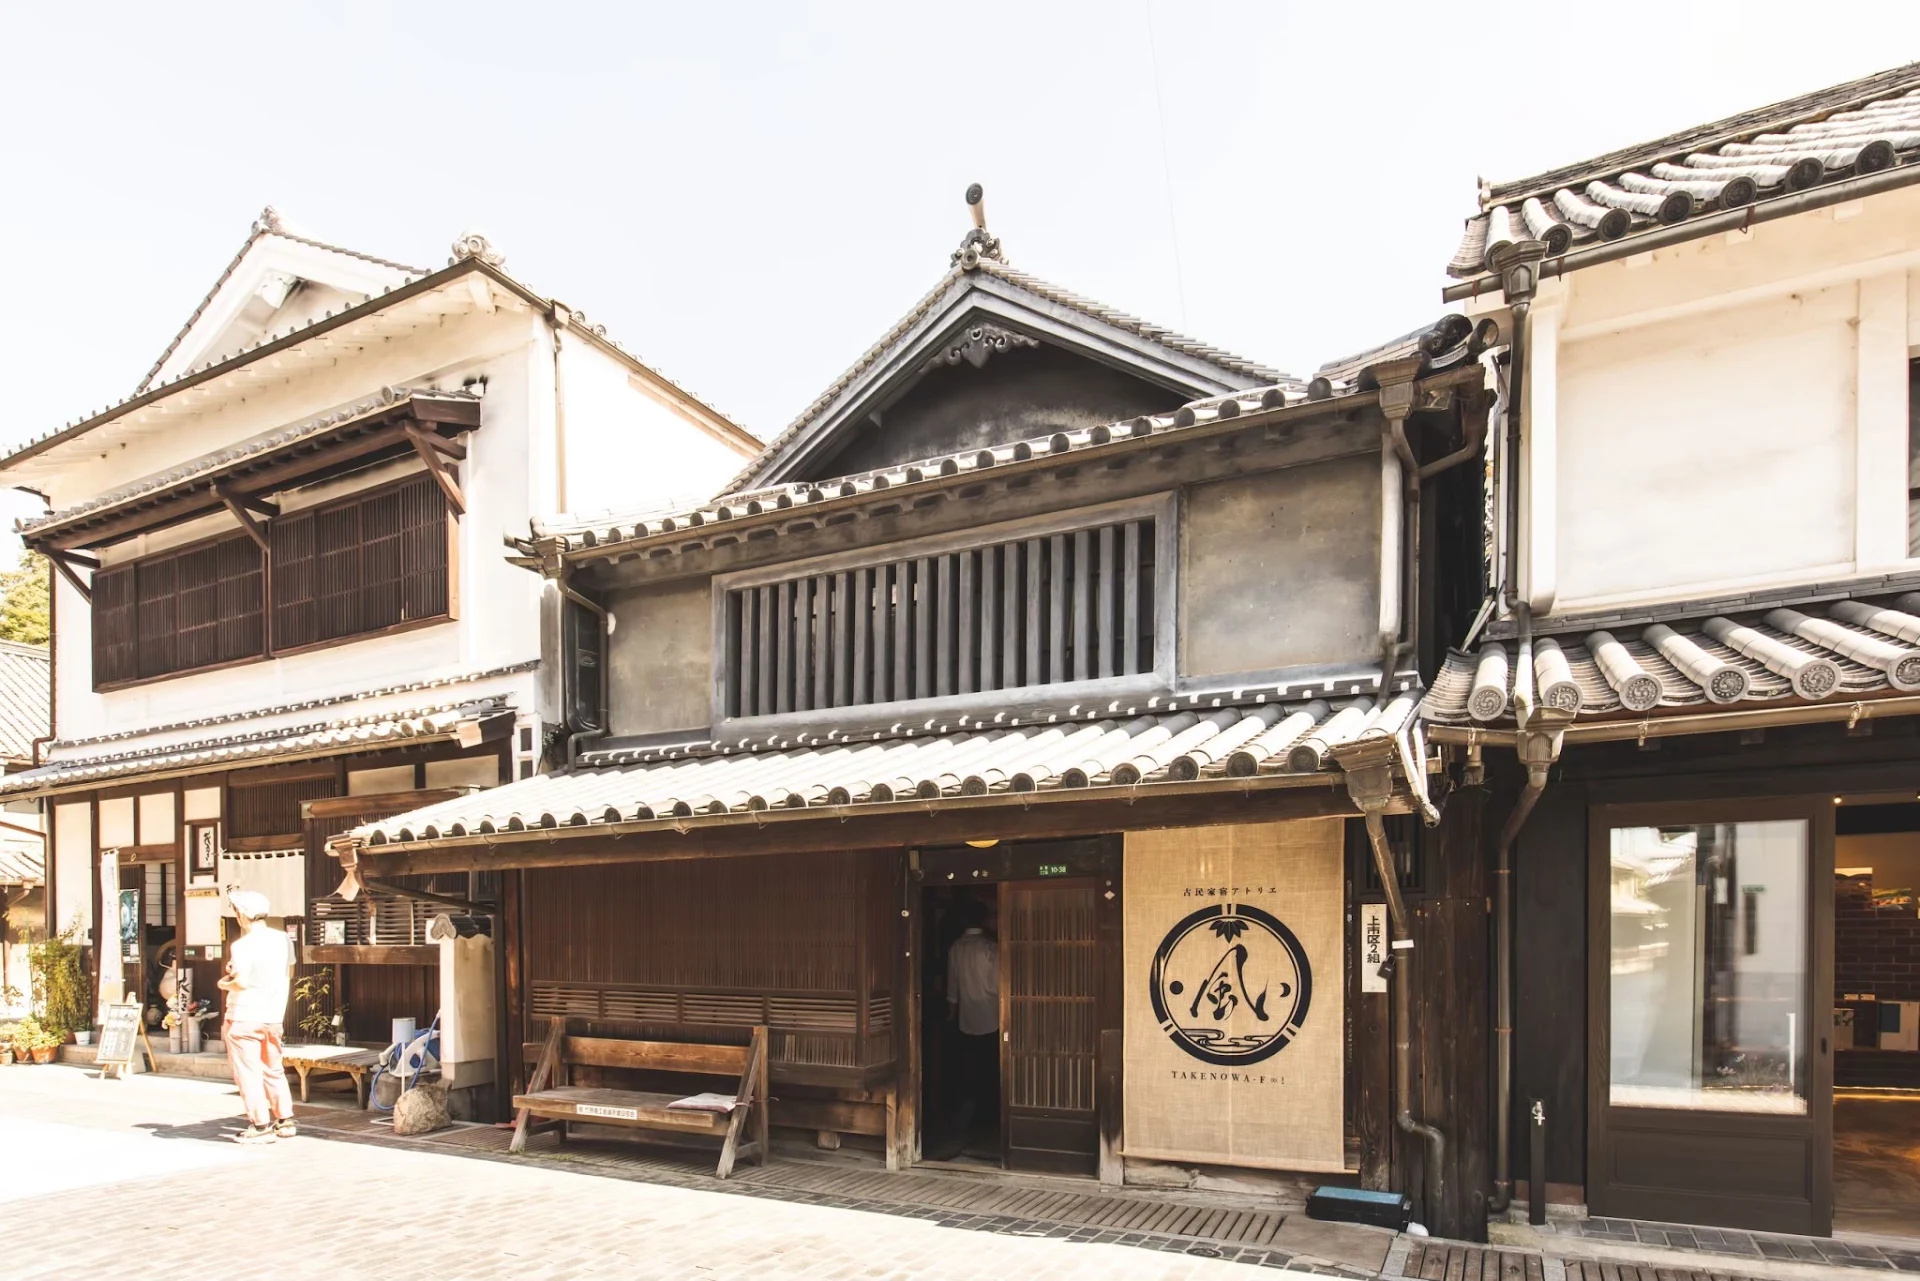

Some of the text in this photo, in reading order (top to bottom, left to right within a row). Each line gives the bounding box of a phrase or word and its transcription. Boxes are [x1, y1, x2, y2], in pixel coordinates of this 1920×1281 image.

[1183, 886, 1277, 897] 古民家宿アトリエ
[1367, 915, 1381, 964] 上市区2組
[1189, 943, 1270, 1022] 風
